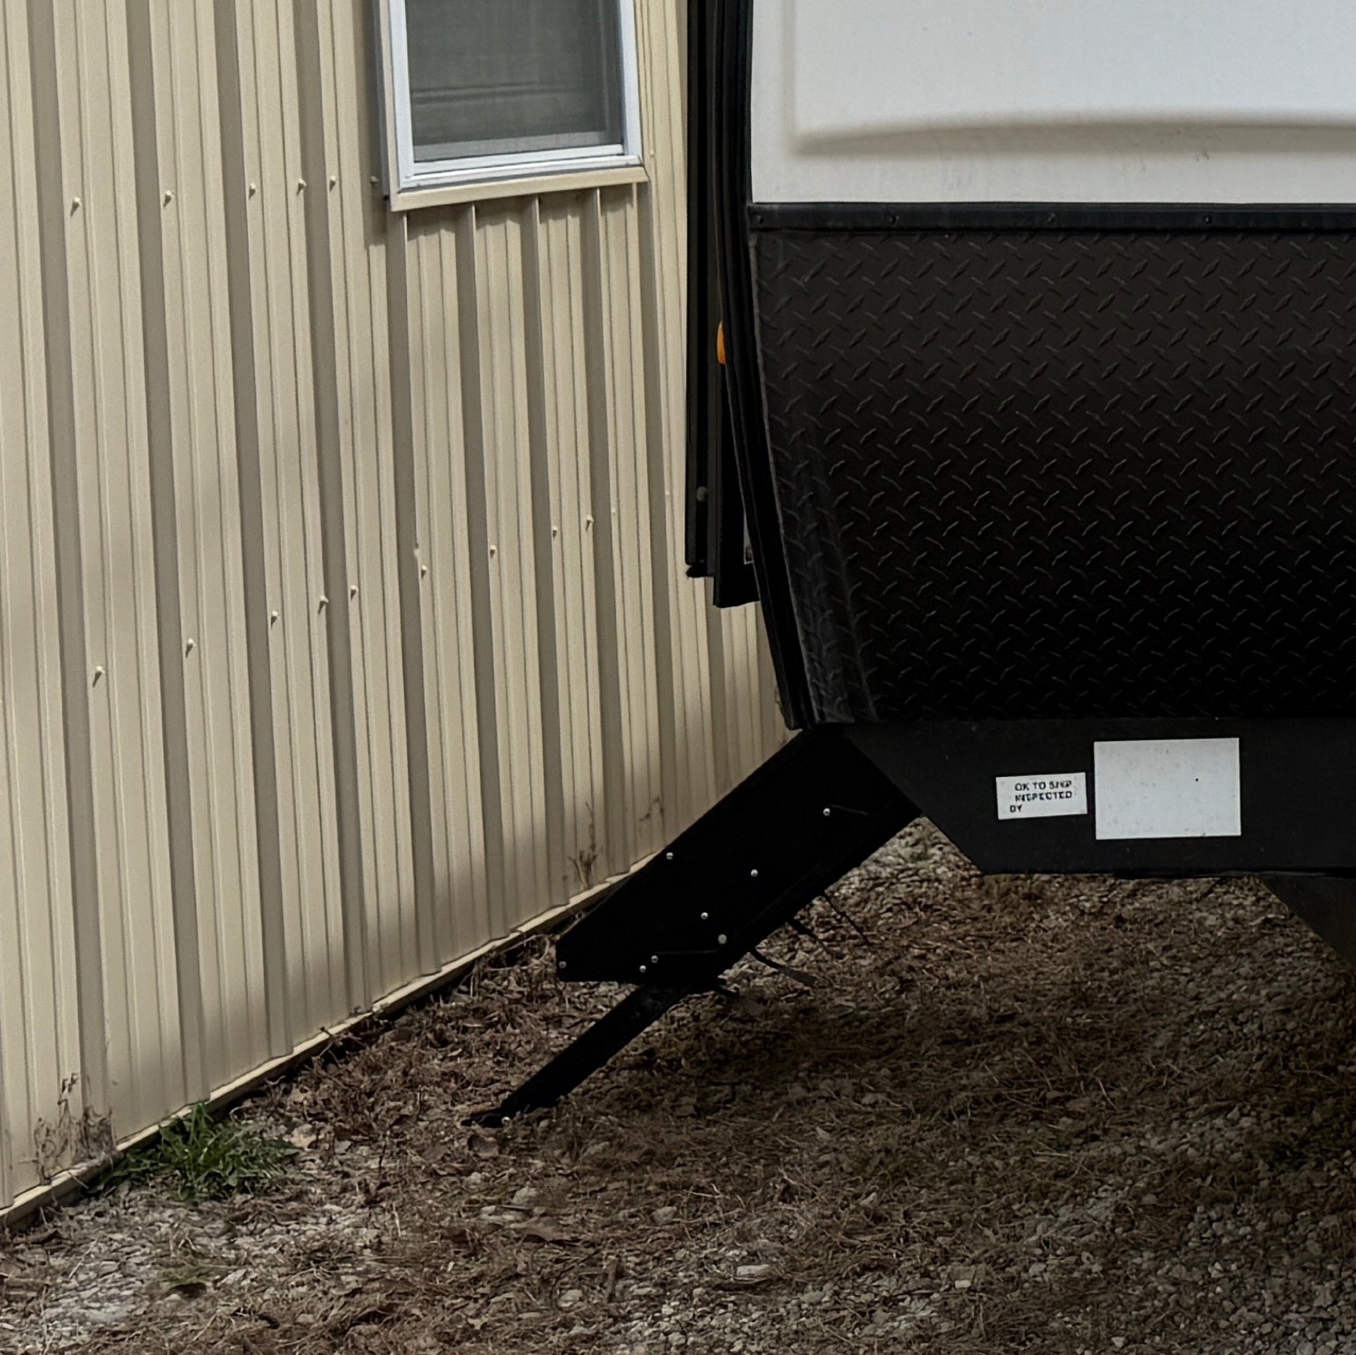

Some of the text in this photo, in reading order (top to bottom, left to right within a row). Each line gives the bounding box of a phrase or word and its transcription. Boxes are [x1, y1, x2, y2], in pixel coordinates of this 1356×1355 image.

[1014, 782, 1030, 791] OK
[1032, 781, 1046, 790] TO
[1014, 790, 1073, 802] INSPECTED
[1009, 804, 1023, 813] BY
